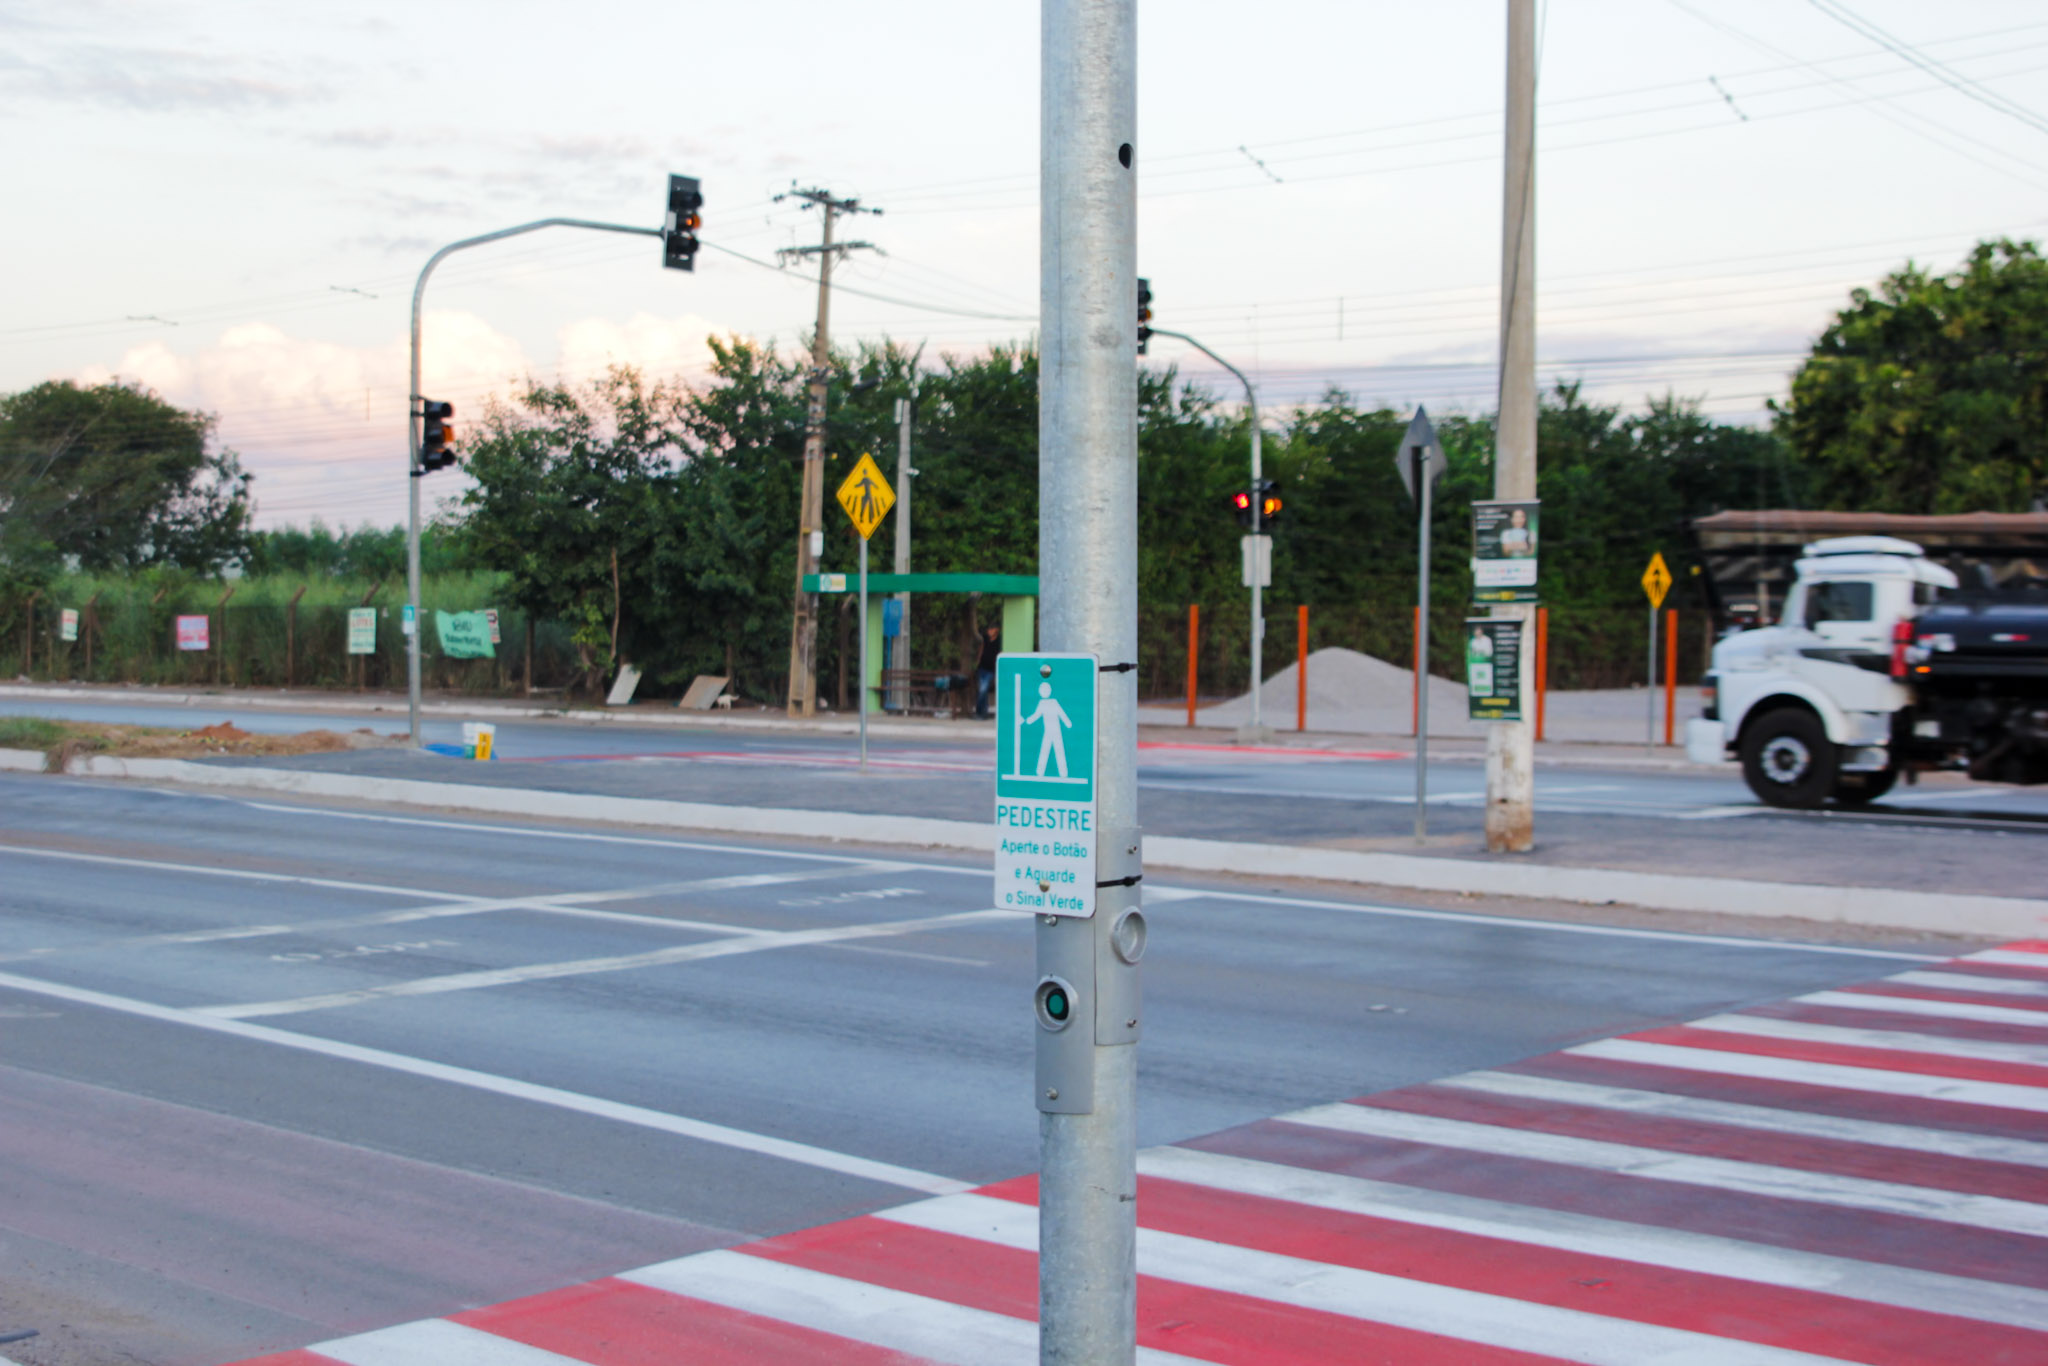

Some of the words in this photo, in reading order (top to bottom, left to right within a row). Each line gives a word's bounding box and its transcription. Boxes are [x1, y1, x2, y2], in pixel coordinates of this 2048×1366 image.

[997, 804, 1091, 831] PEDESTRE
[1001, 838, 1039, 855] Aperte
[1043, 844, 1050, 855] o
[1054, 841, 1087, 858] Botão
[1015, 868, 1021, 879] e
[1025, 866, 1075, 885] Aguarde
[1006, 893, 1013, 904] o
[1017, 890, 1045, 907] Sinal
[1049, 893, 1084, 910] Verde
